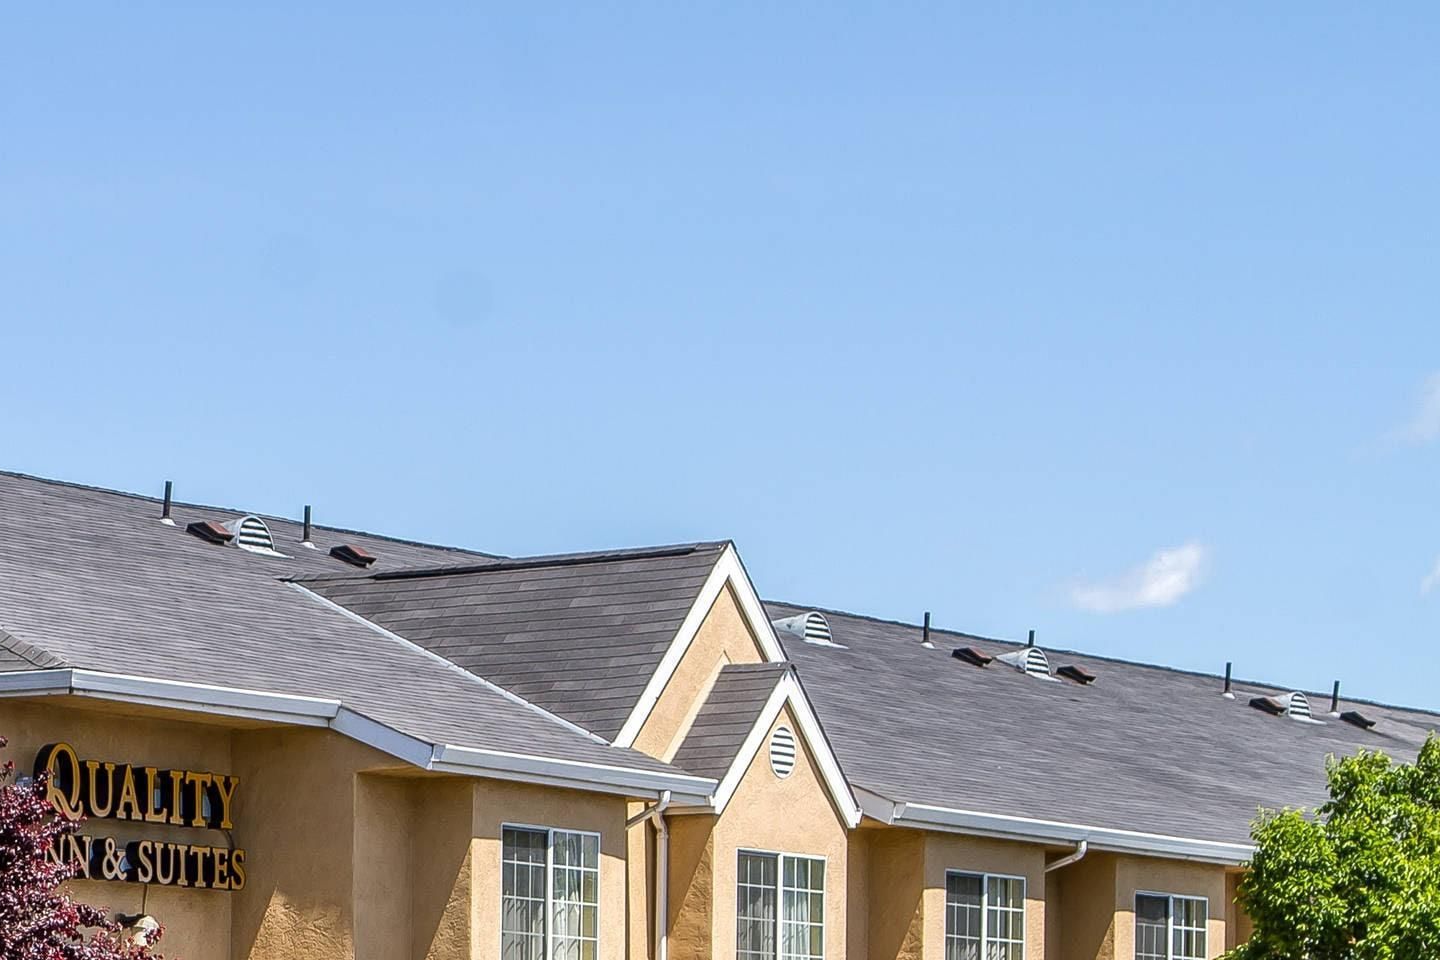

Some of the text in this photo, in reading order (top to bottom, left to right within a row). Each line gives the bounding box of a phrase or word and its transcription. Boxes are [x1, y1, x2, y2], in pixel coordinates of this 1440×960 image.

[40, 742, 240, 829] QUALITY
[43, 834, 246, 890] NN & SUITES
